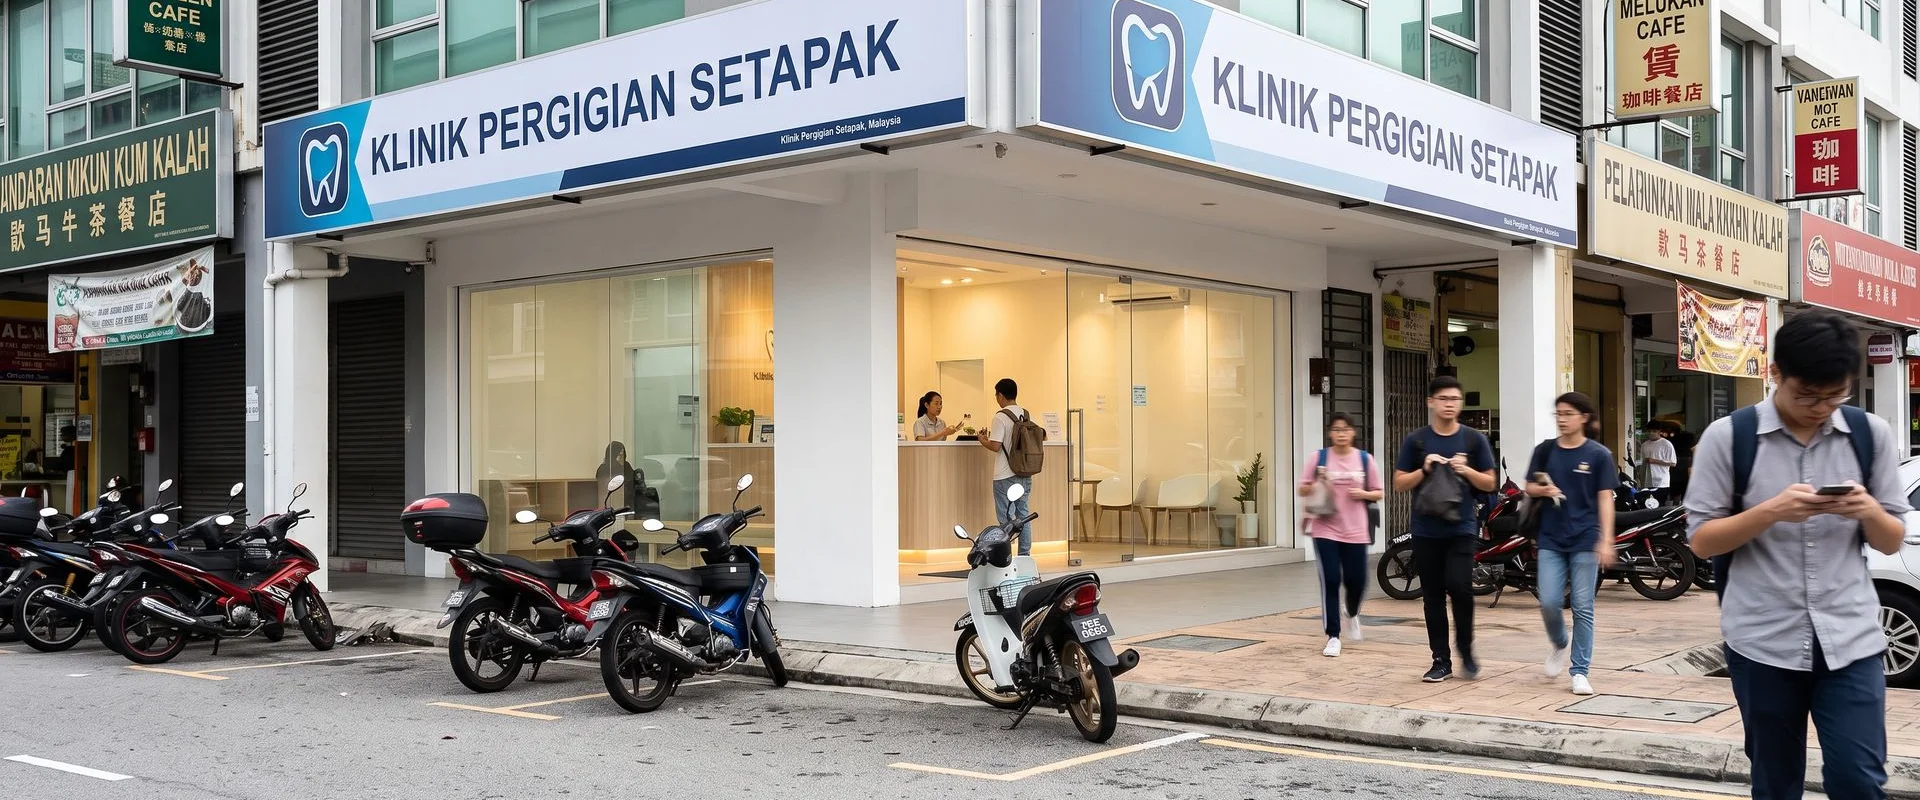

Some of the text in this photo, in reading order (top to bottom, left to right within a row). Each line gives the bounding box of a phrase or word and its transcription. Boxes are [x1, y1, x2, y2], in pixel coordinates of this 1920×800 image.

[149, 2, 201, 26] CAFE
[1637, 14, 1686, 40] CAFE
[371, 19, 900, 175] KLINIK PERGIGIAN SETAPAK
[1622, 83, 1703, 109] 珈啡餐店
[1814, 102, 1839, 116] MOT
[781, 115, 901, 144] Klinik Pergigian Setapak, Malaysia
[1213, 57, 1558, 201] KLINIK PERGIGIAN SETAPAK
[1811, 116, 1841, 129] CAFE
[114, 140, 148, 189] KUM
[153, 126, 209, 181] KALAH
[1752, 209, 1783, 253] KALAH
